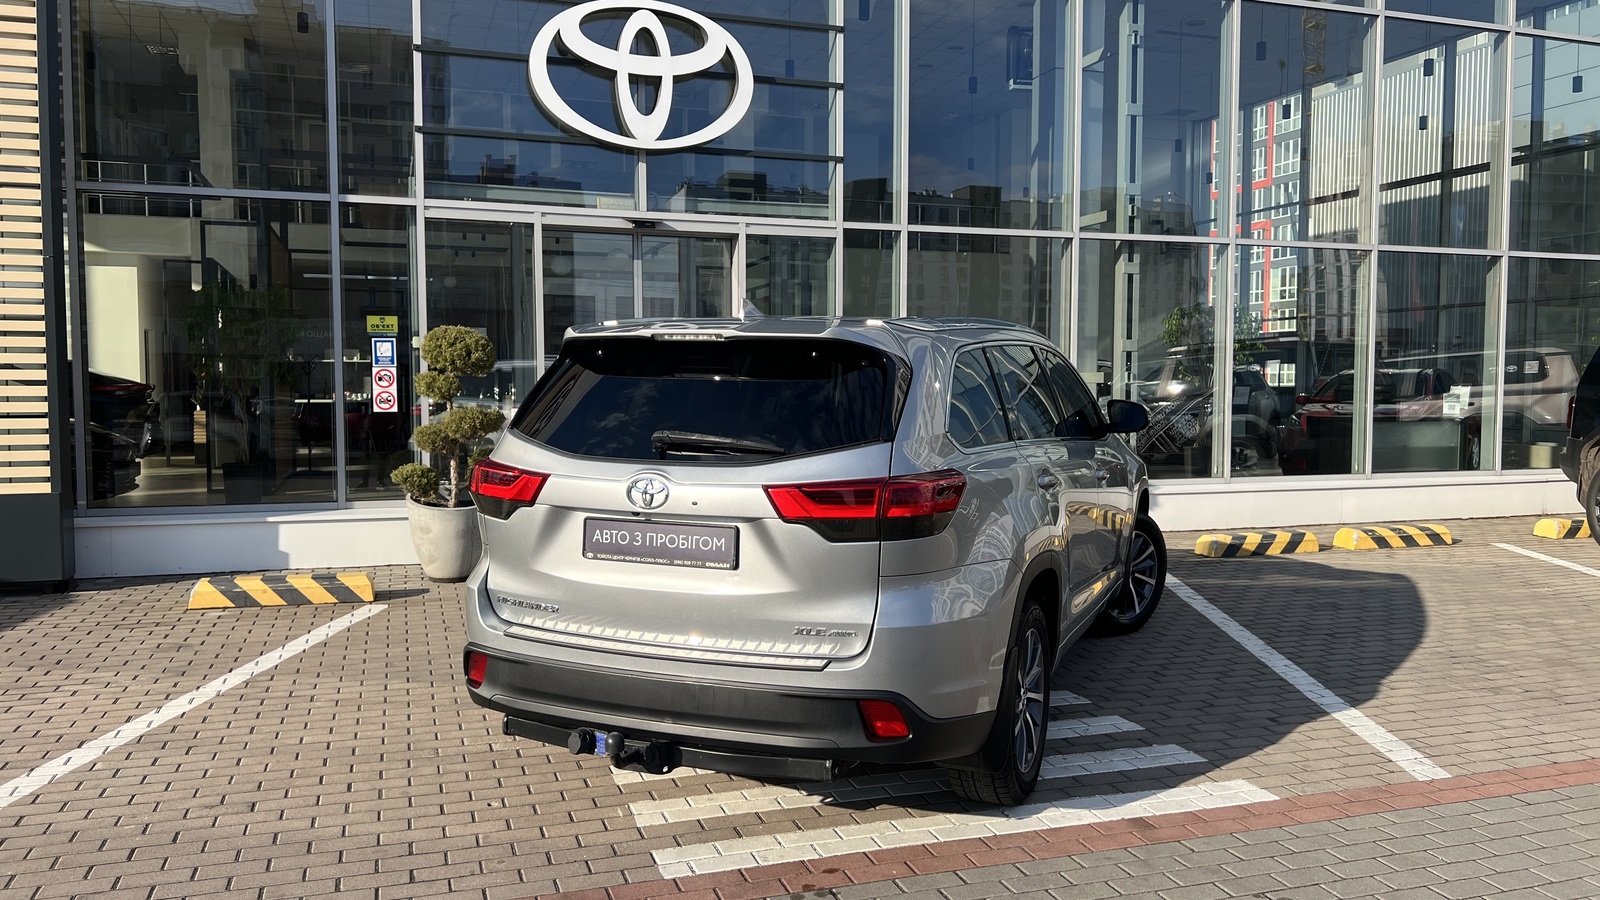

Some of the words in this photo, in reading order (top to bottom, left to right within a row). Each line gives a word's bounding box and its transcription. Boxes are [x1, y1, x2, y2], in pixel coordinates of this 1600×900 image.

[592, 529, 630, 545] АВТО
[646, 532, 725, 551] ПРОБІГОМ
[496, 595, 560, 614] HIGHLANDER
[793, 626, 827, 637] XLE
